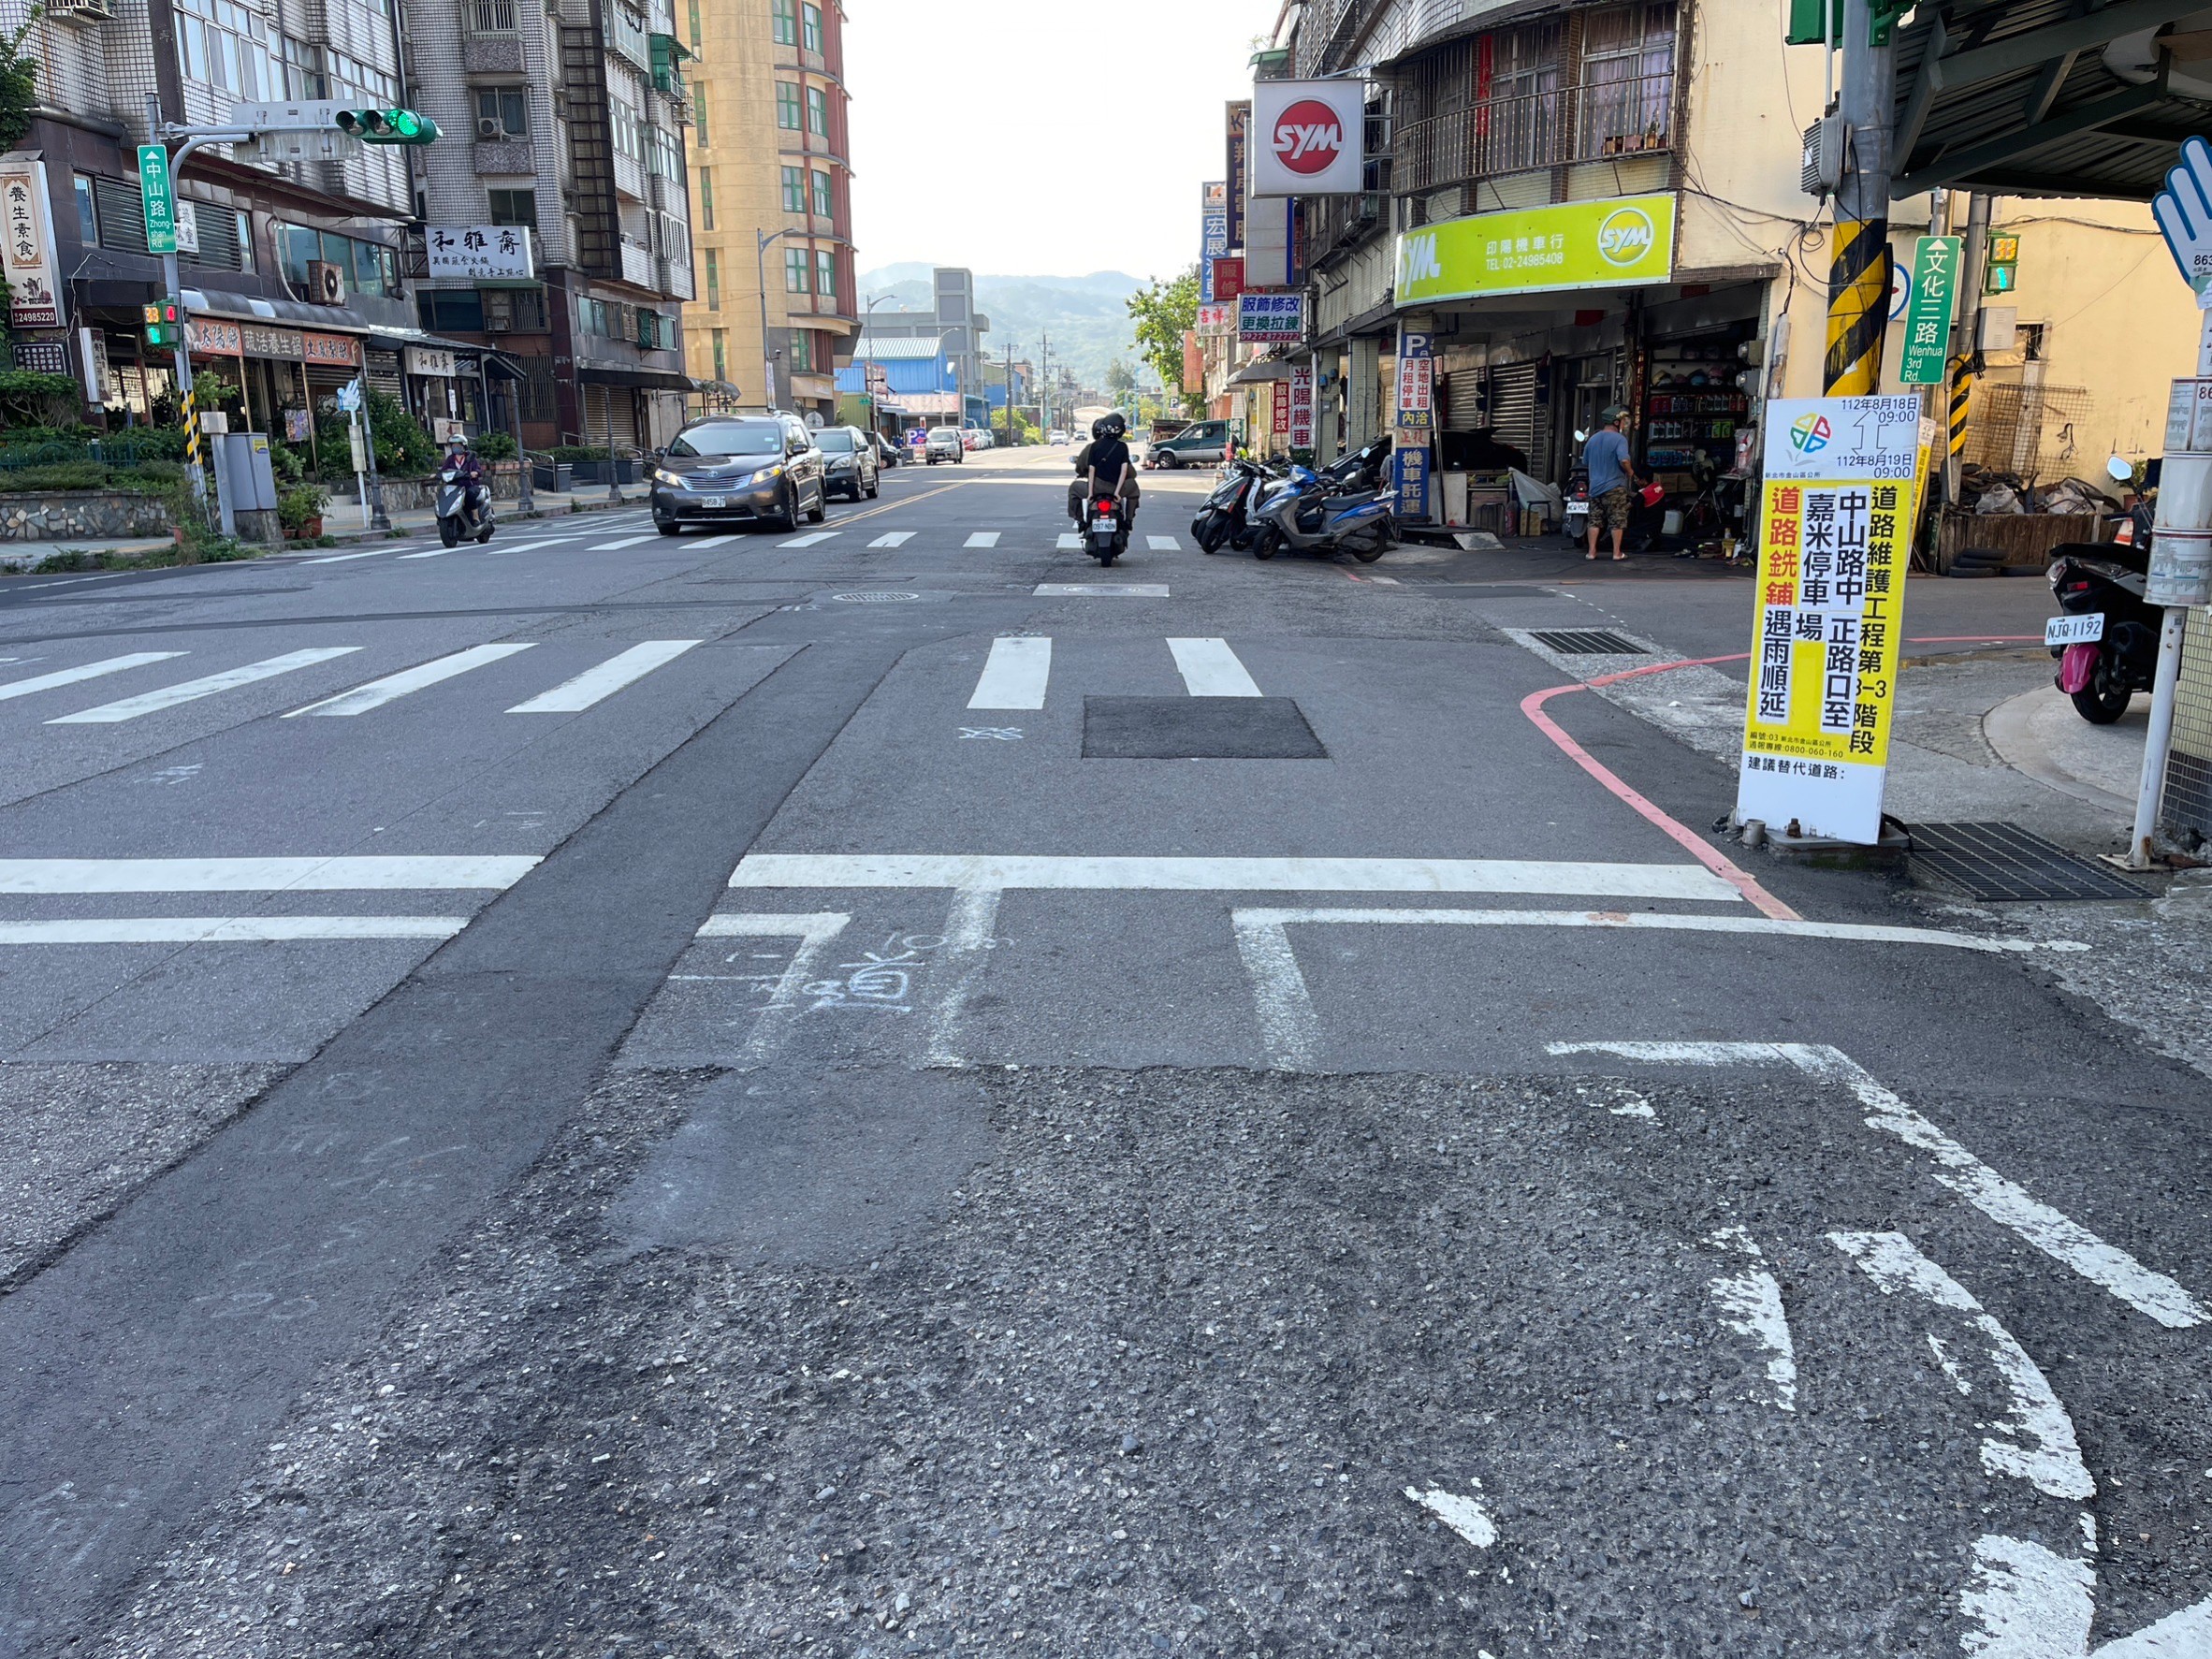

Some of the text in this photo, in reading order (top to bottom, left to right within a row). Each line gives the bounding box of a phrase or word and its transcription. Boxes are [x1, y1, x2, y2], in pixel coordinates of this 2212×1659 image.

[1273, 123, 1343, 159] SYM
[146, 162, 166, 217] 中山路
[8, 186, 34, 256] 養生素食
[150, 219, 171, 229] Zhong-
[1486, 234, 1564, 256] 印陽機車行
[1600, 226, 1652, 255] SYM
[1995, 238, 2017, 260] 33
[1399, 233, 1441, 296] SYM
[1242, 297, 1300, 312] 服飾修改
[1914, 252, 1949, 344] 文化三路
[19, 313, 54, 322] 24985220
[1241, 316, 1300, 330] 更換拉鍊
[243, 329, 303, 357] 蔬活養生鍋
[1406, 335, 1426, 357] P
[1909, 344, 1943, 357] Wenhua
[1907, 358, 1922, 370] 3rd
[1402, 360, 1414, 408] 月租停車
[1417, 359, 1430, 408] 空地出租
[1904, 371, 1920, 382] Rd.
[1292, 368, 1310, 446] 光陽機車
[1841, 398, 1917, 411] 112年8月18日
[1402, 412, 1429, 425] 內洽
[1878, 411, 1915, 423] 09:00
[908, 429, 918, 444] P
[1837, 454, 1912, 467] 112年8月19日
[1401, 449, 1423, 514] 機車託運
[1873, 467, 1910, 478] 09:00
[2047, 621, 2102, 638] NJQ-1192
[1781, 735, 1831, 748] 新北市金山區公所
[1747, 756, 1845, 779] 建議替代道路:
